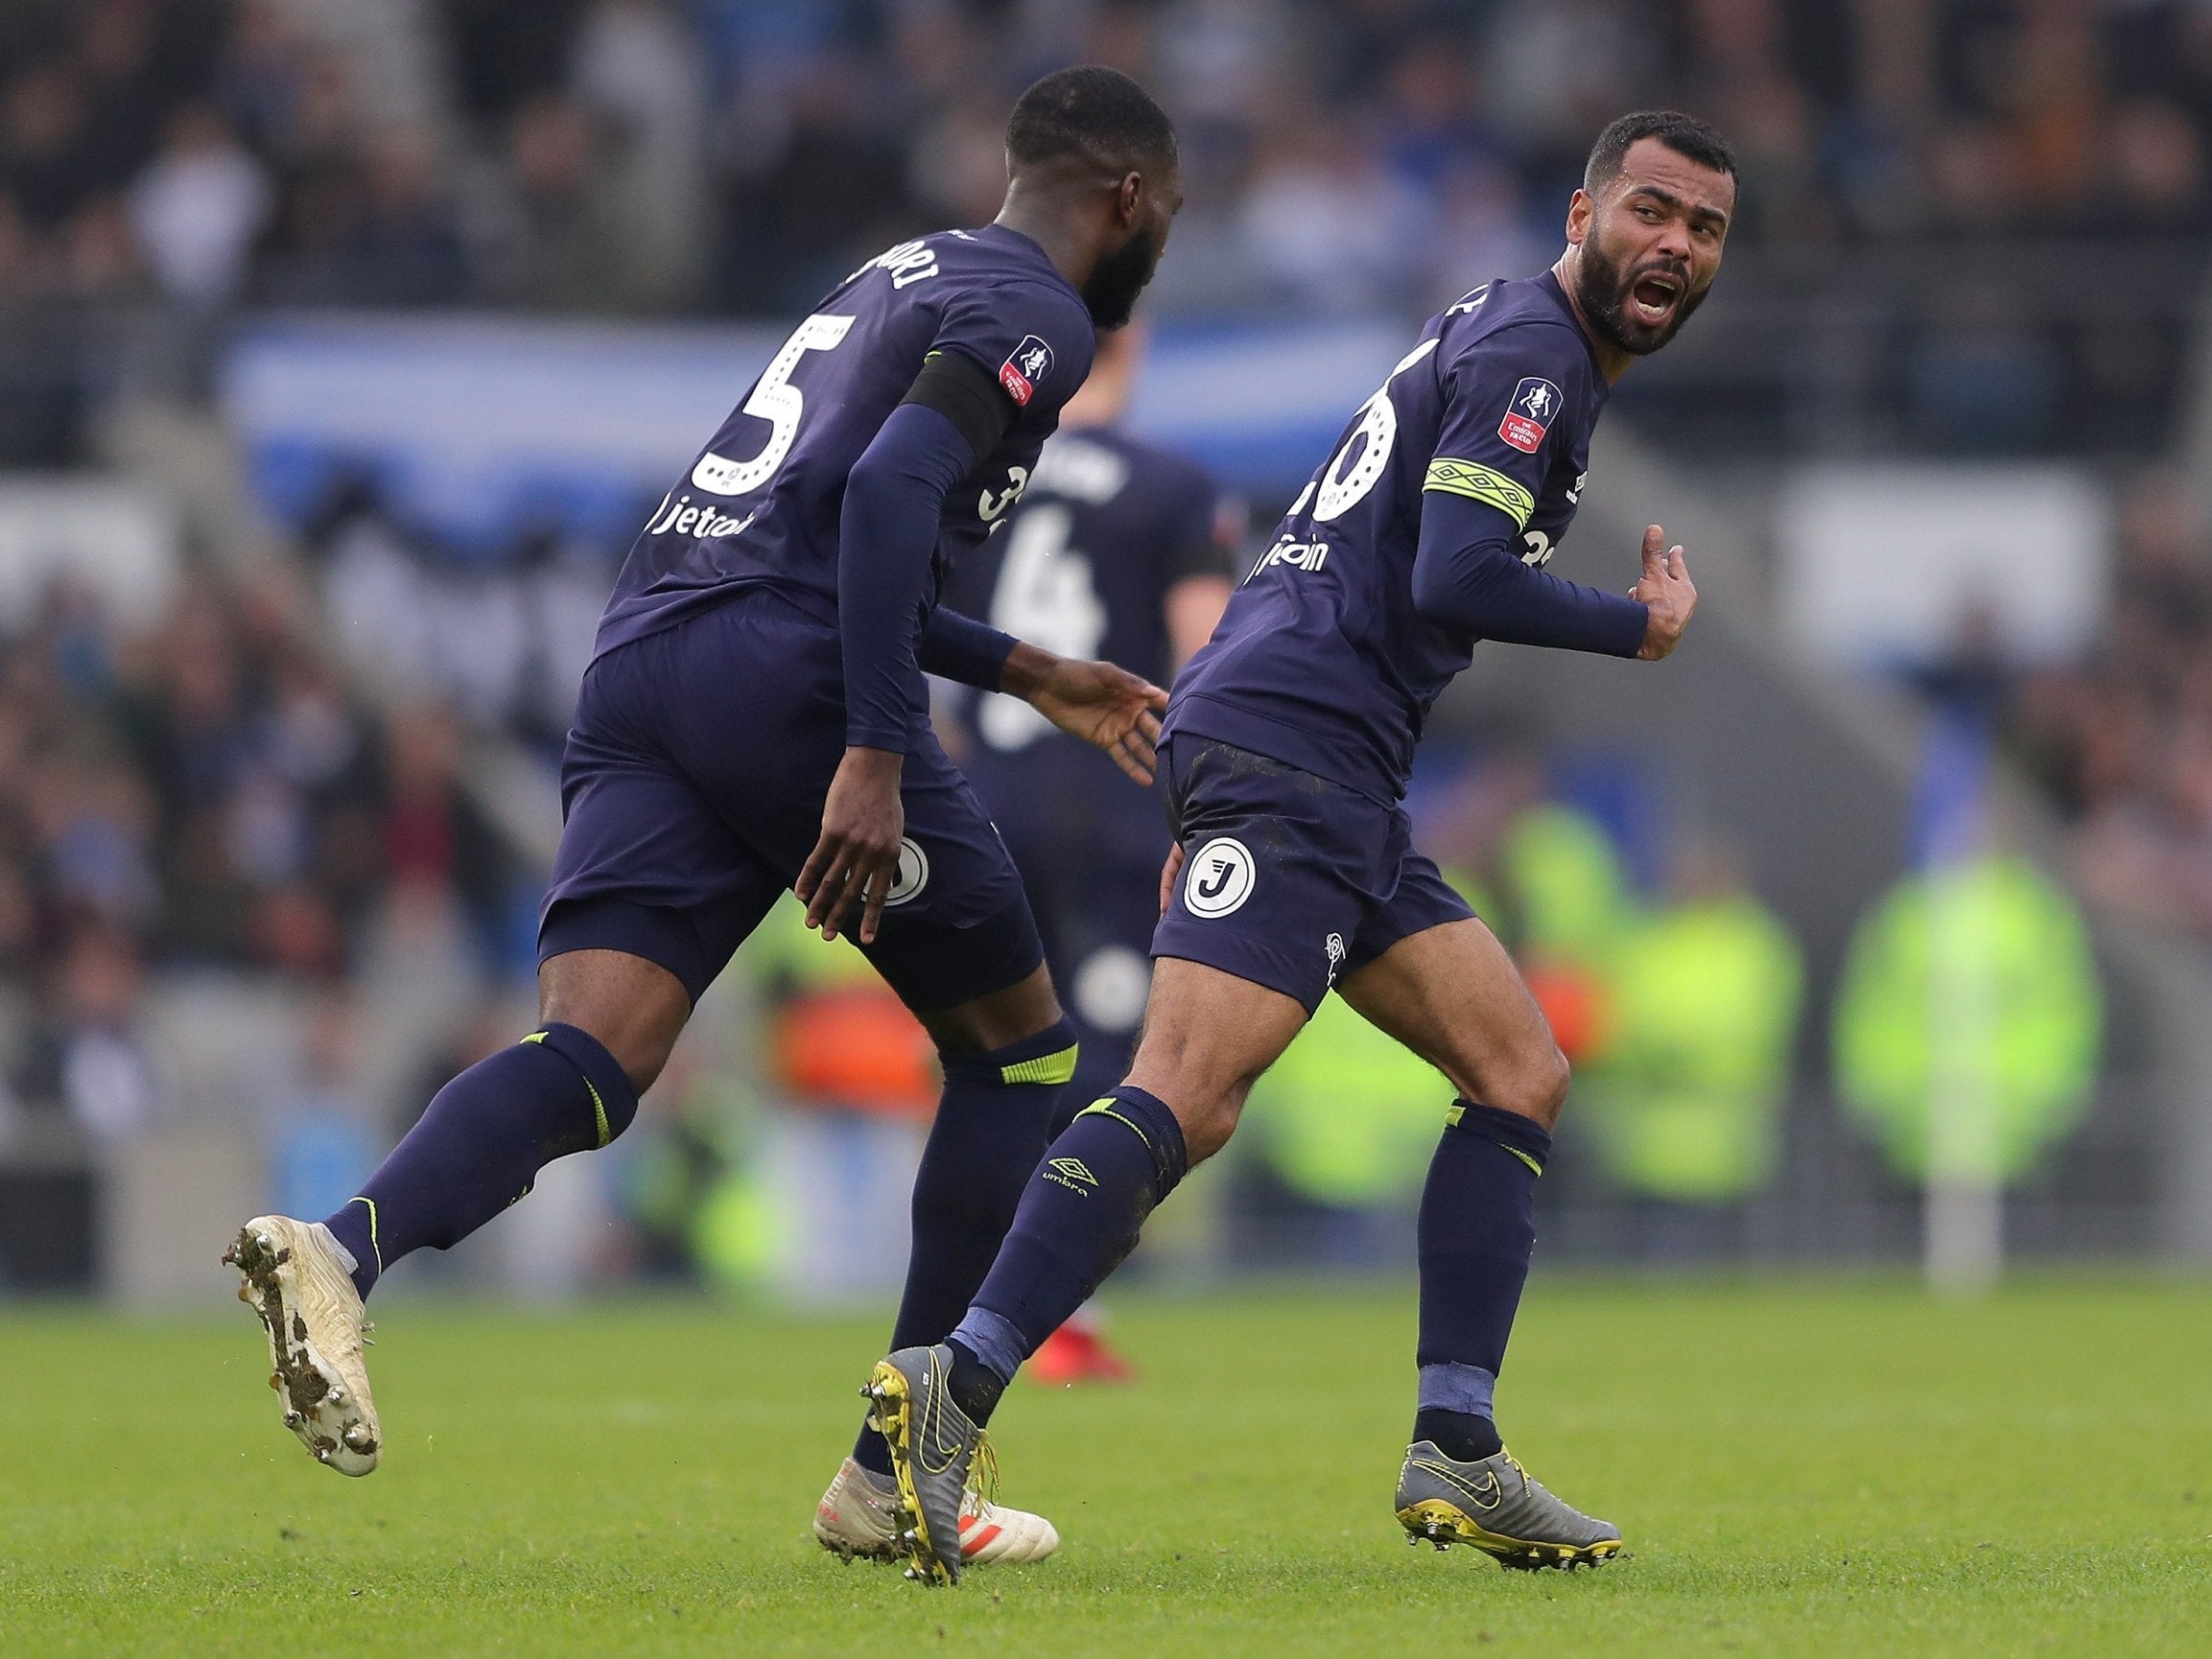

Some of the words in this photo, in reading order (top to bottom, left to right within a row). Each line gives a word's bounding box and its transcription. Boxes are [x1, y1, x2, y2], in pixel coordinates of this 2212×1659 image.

[691, 314, 857, 497] 5
[1507, 421, 1538, 442] Emirates
[1509, 431, 1518, 440] FA
